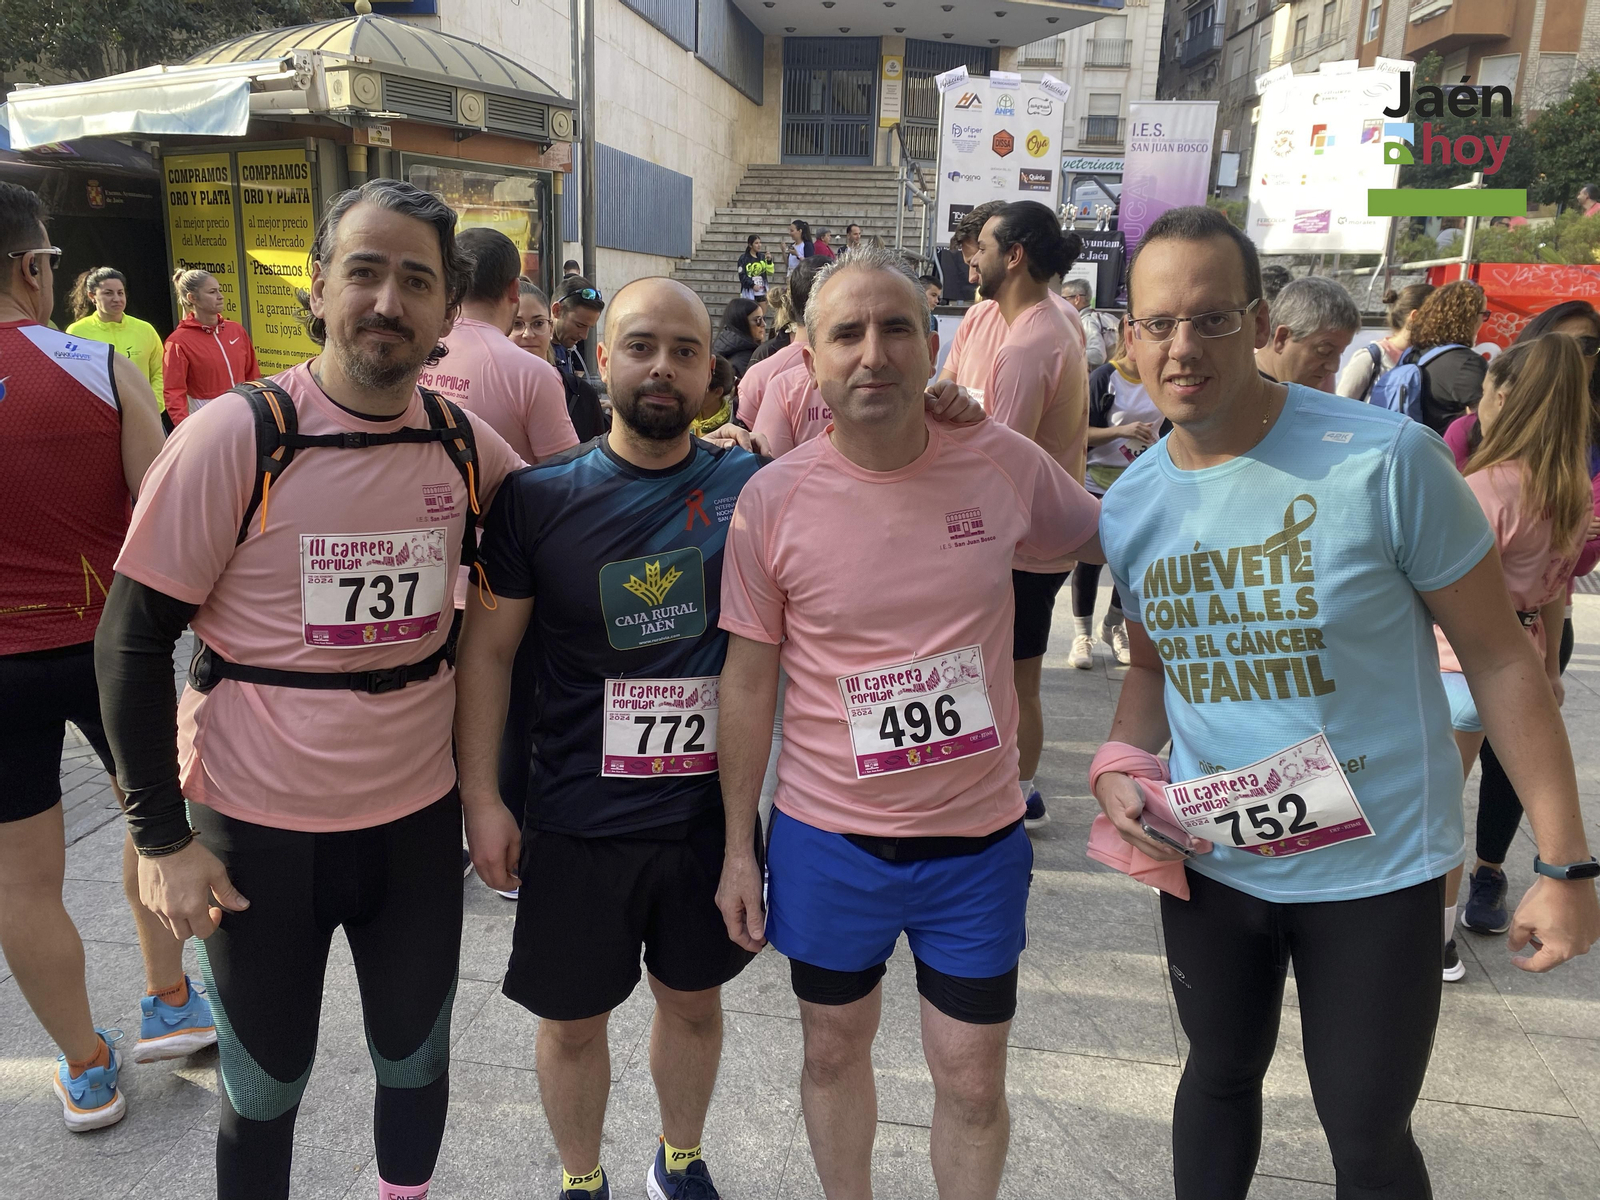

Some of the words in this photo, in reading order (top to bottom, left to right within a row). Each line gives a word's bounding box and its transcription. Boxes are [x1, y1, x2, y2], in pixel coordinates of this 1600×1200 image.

[995, 107, 1015, 116] ANPE
[1132, 122, 1165, 138] I.E.S.
[995, 139, 1012, 148] DISSA
[1131, 143, 1150, 152] SAN
[1151, 143, 1175, 154] JUAN
[1177, 144, 1209, 153] BOSCO
[168, 166, 228, 184] COMPRAMOS
[242, 163, 308, 181] COMPRAMOS
[170, 191, 189, 206] ORO
[191, 190, 197, 205] Y
[200, 189, 231, 206] PLATA
[244, 188, 264, 205] ORO
[266, 188, 274, 205] Y
[276, 187, 311, 204] PLATA
[175, 216, 182, 228] al
[183, 216, 205, 231] mejor
[206, 216, 230, 231] precio
[248, 214, 256, 228] al
[257, 215, 281, 231] mejor
[282, 215, 309, 232] precio
[182, 233, 193, 246] del
[194, 234, 227, 247] Mercado
[255, 233, 268, 247] del
[269, 234, 305, 248] Mercado
[1087, 250, 1109, 260] Jaén
[227, 260, 235, 274] al
[256, 281, 294, 298] instante,
[226, 298, 237, 312] de
[256, 300, 265, 314] la
[265, 322, 279, 334] tus
[280, 322, 302, 339] joyas
[309, 538, 326, 557] III
[1143, 539, 1315, 599] MUÉVETE
[339, 572, 419, 622] 737
[615, 612, 649, 627] CAJA
[651, 602, 698, 619] RURAL
[1145, 597, 1199, 632] CON
[641, 617, 675, 636] JAÉN
[1194, 633, 1221, 659] EL
[1225, 624, 1327, 656] CÁNCER
[845, 676, 861, 694] III
[1164, 654, 1337, 705] NFANTIL
[612, 682, 626, 697] III
[851, 709, 873, 717] 2024
[879, 694, 962, 748] 496
[634, 714, 706, 755] 772
[1173, 786, 1190, 806] III
[1186, 818, 1210, 828] 2024
[1213, 793, 1319, 847] 752
